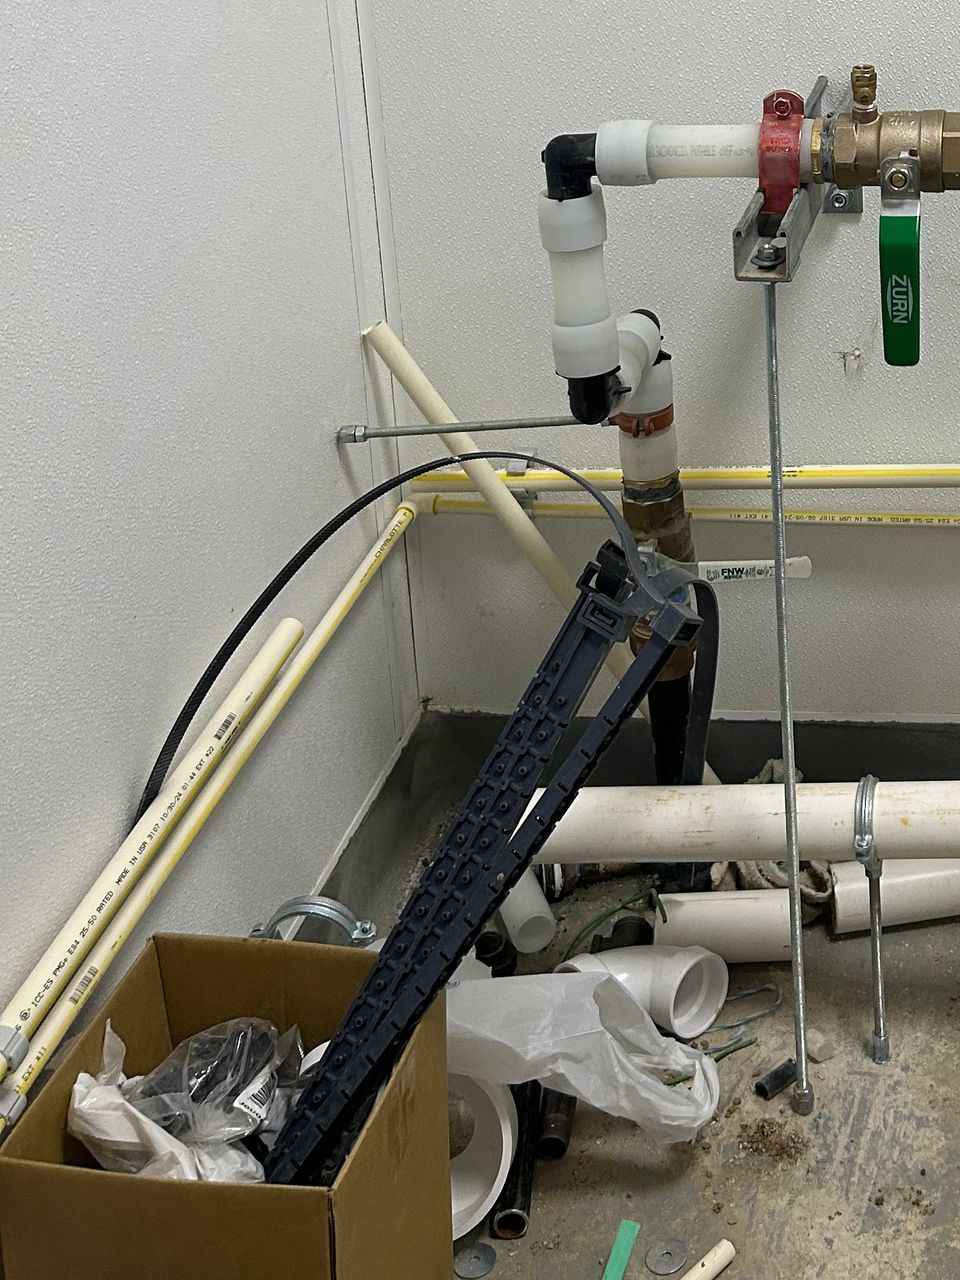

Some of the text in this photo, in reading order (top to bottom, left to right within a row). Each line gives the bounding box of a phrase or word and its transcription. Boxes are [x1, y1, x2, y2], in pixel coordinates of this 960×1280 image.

[891, 274, 908, 324] ZURN
[721, 567, 745, 577] FNW
[30, 977, 54, 1007] ICC-ES
[66, 939, 81, 955] E84
[78, 913, 98, 938] 25/50
[94, 889, 114, 914] RATED
[114, 866, 131, 885] MADE
[128, 855, 138, 866] IN
[135, 840, 149, 855] USA
[146, 822, 161, 840] 3107
[159, 791, 183, 821] 10/30/24
[194, 758, 206, 771] EXT
[20, 1063, 36, 1082] EXT
